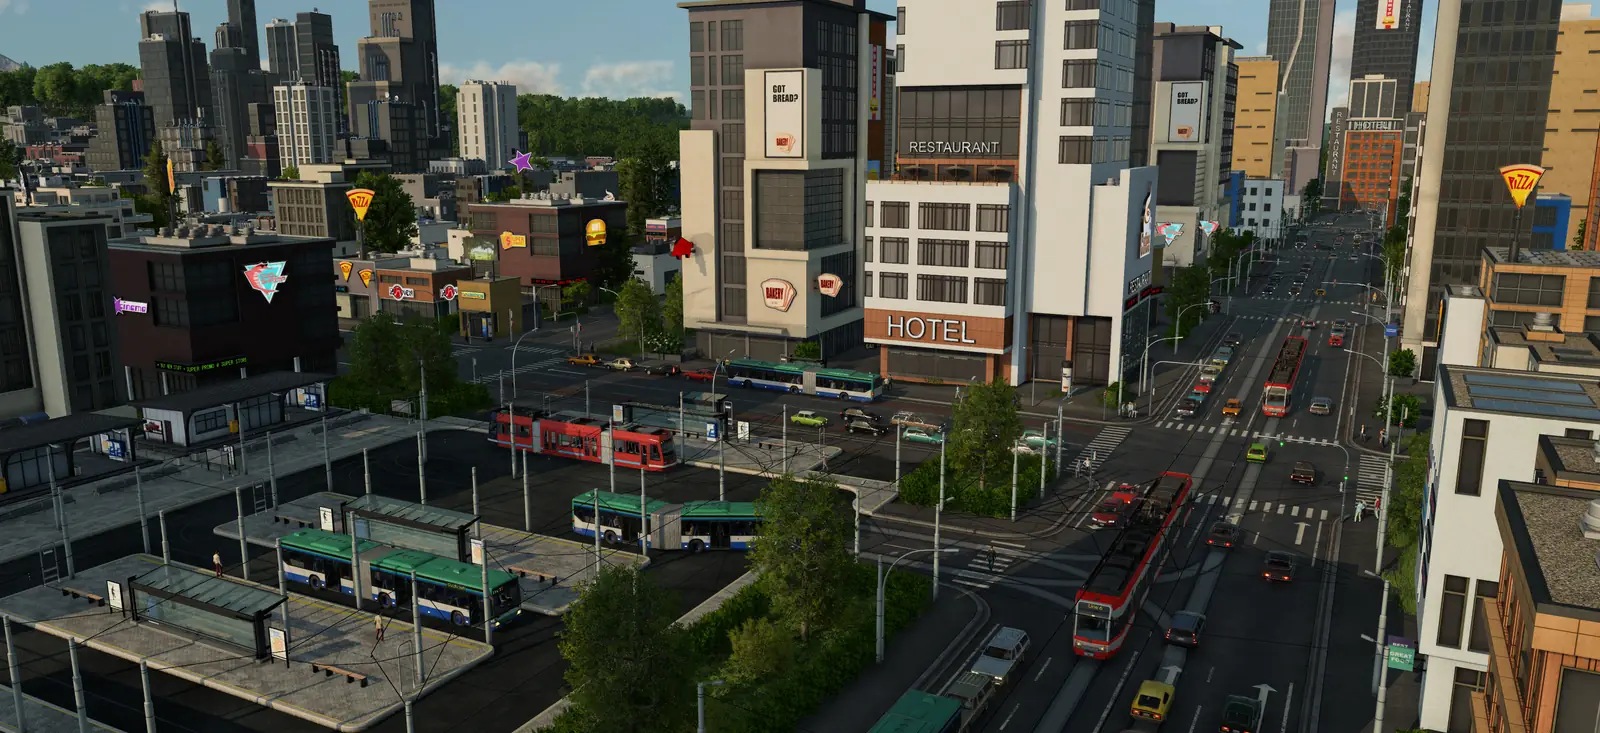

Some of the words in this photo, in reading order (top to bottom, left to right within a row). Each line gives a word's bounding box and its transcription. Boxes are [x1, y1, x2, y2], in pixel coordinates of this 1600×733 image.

[773, 85, 786, 93] GOT
[773, 94, 799, 102] BREAD?
[909, 141, 1000, 153] RESTAURANT
[1331, 111, 1343, 176] RESTAURANT
[1508, 174, 1535, 190] PIZZA
[351, 196, 369, 208] PIZZA
[820, 280, 835, 289] BAKERY
[765, 287, 784, 299] BAKERY
[888, 315, 976, 343] HOTEL
[1390, 651, 1412, 659] GREAT
